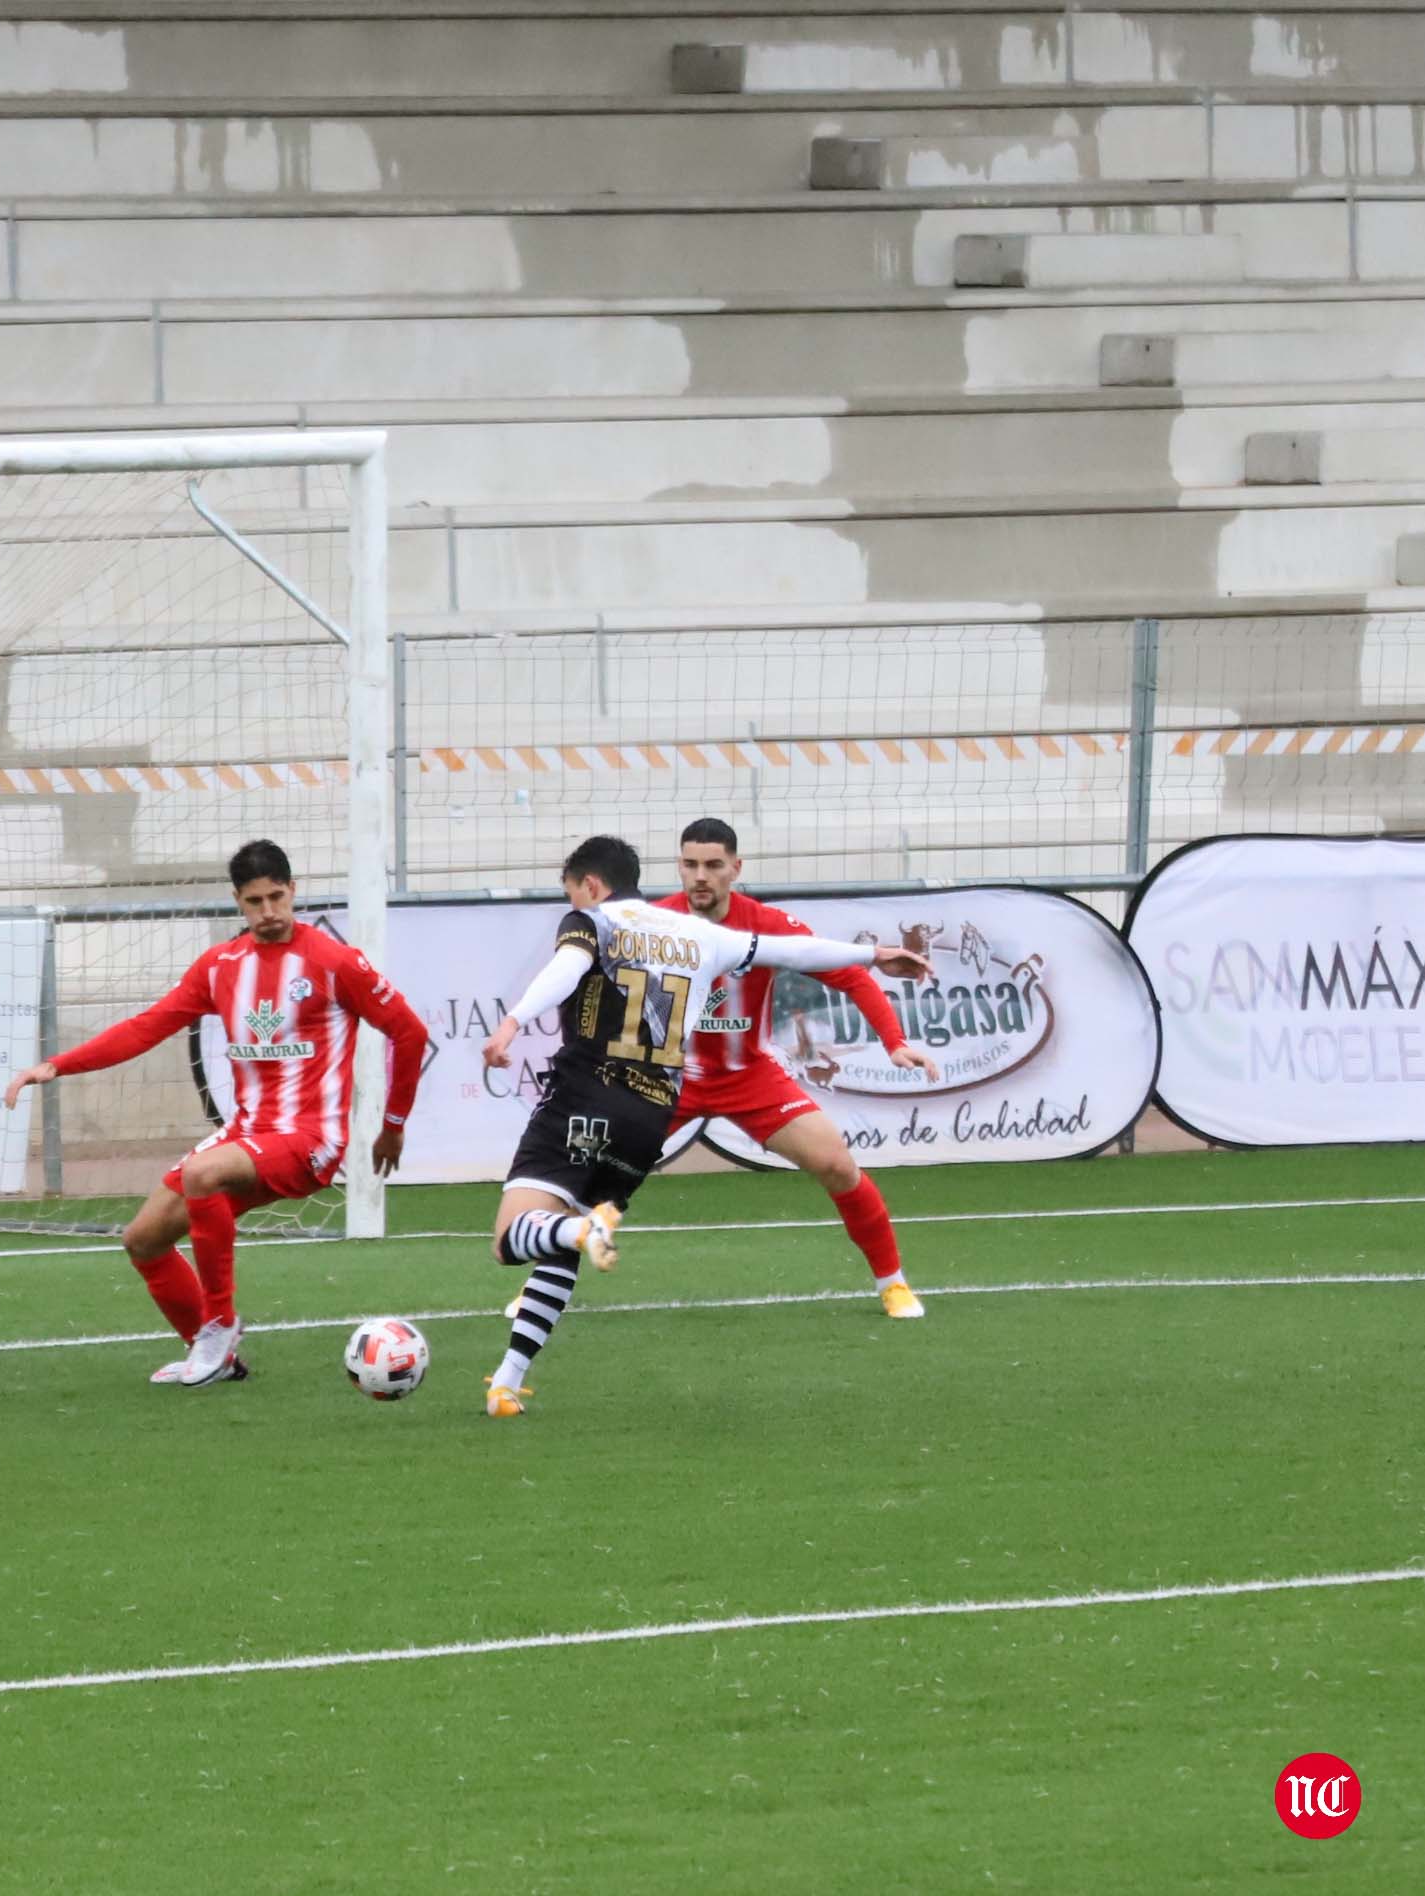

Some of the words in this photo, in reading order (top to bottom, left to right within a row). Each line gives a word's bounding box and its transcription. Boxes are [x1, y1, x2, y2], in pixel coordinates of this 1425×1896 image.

[607, 928, 646, 963] JON
[648, 934, 701, 971] ROJO
[606, 966, 692, 1068] 11
[701, 1018, 751, 1030] RURAL
[261, 1043, 313, 1058] RURAL
[843, 1062, 922, 1083] cereales
[943, 1039, 1011, 1083] piensos
[461, 1084, 481, 1098] DE
[899, 1106, 938, 1147] de
[953, 1094, 1091, 1144] Calidad
